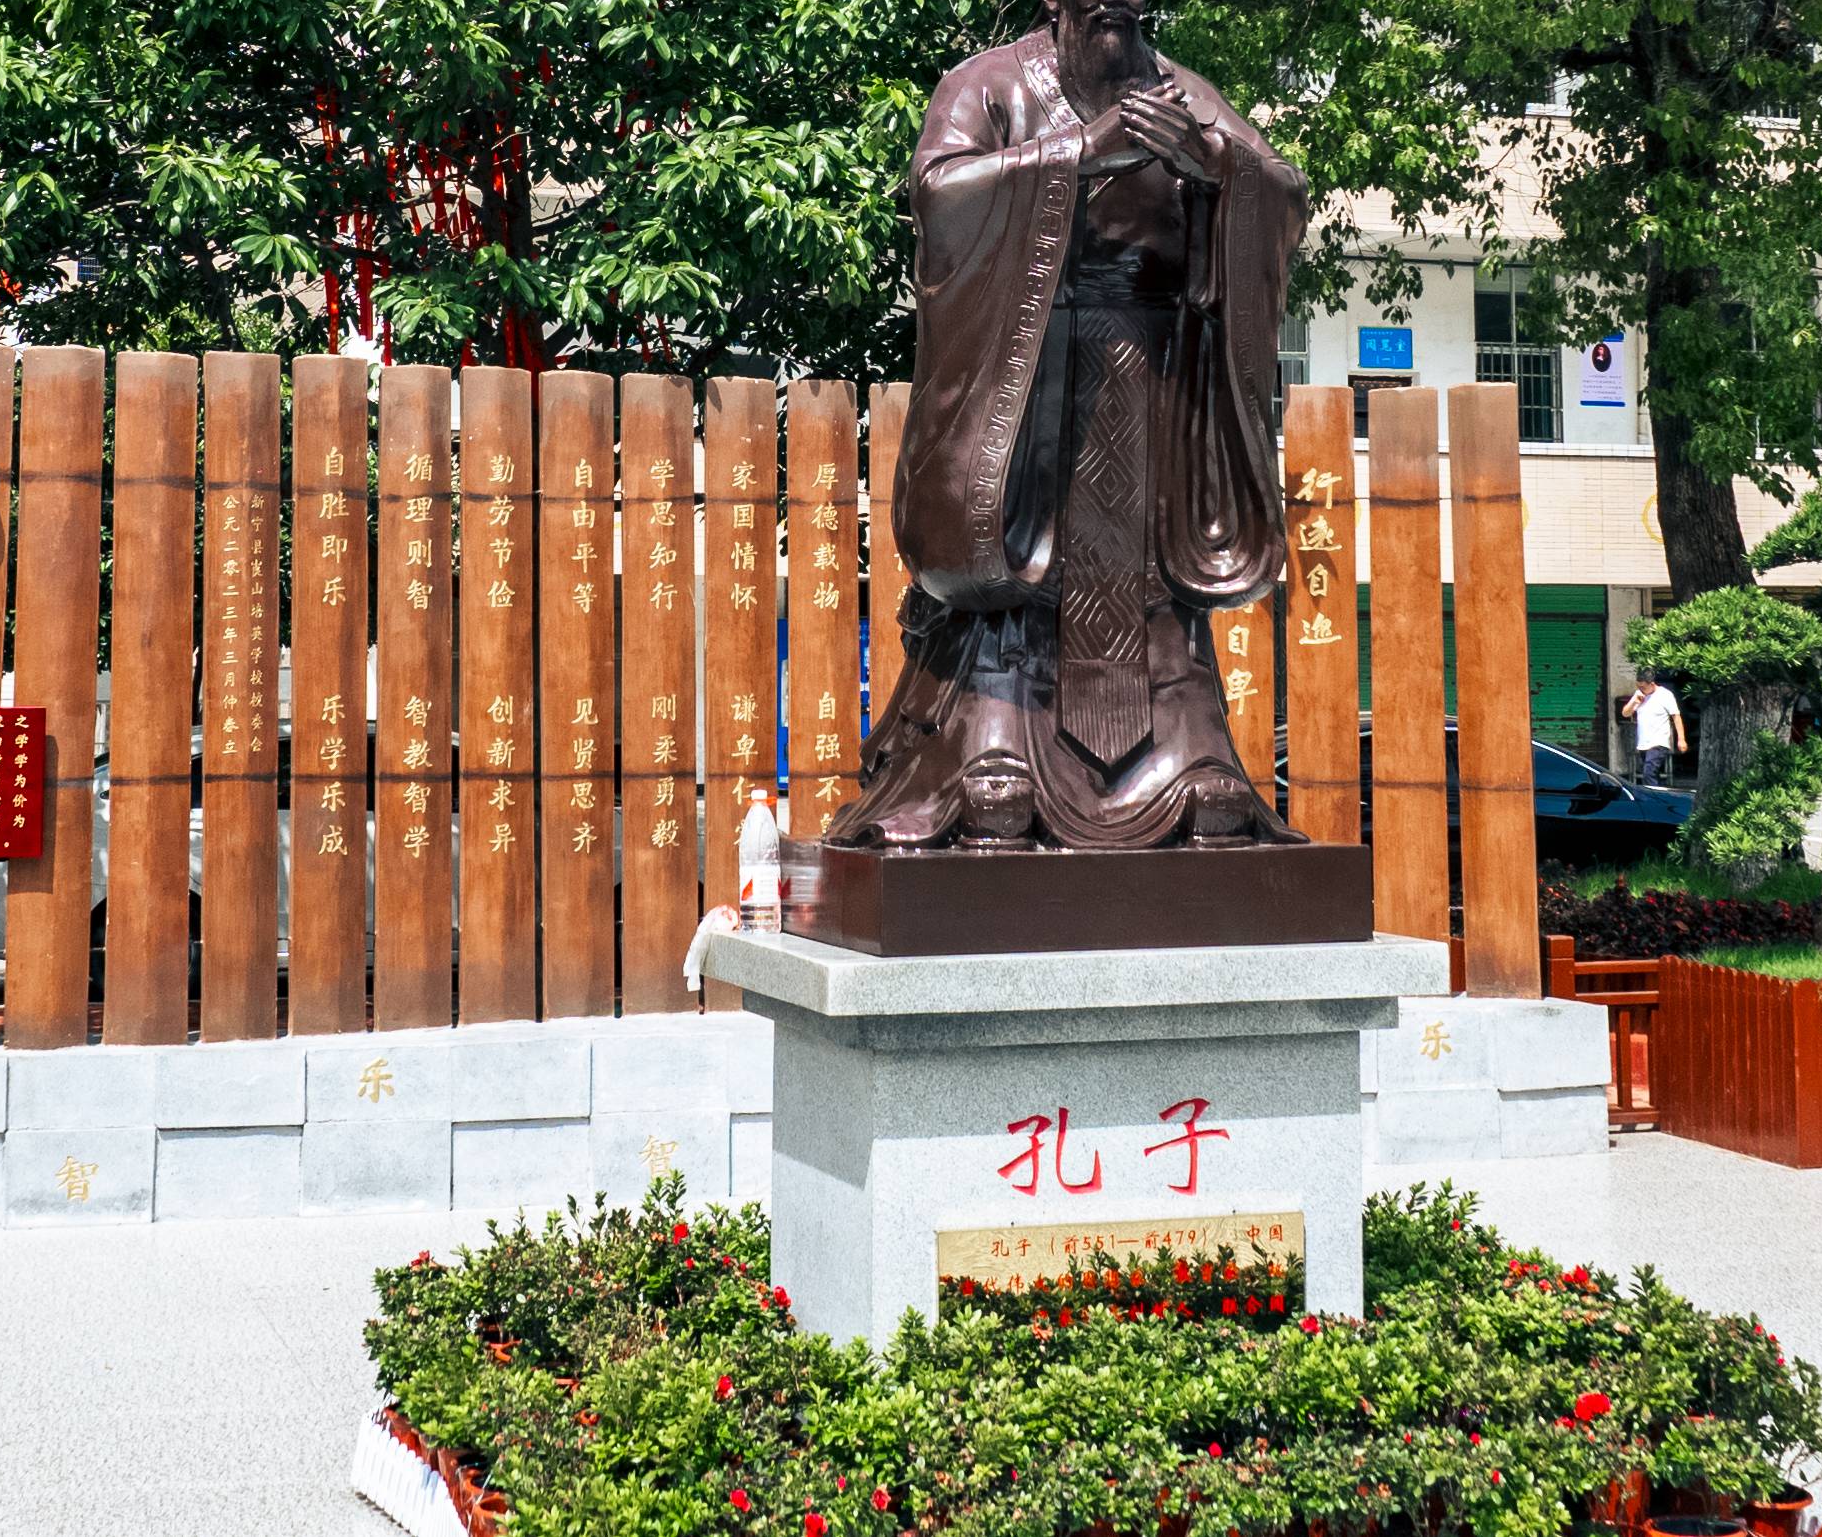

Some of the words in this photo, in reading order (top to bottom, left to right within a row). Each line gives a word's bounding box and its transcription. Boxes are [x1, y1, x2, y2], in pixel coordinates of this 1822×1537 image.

[318, 445, 351, 606] 自胜即乐
[401, 451, 433, 610] 循理则智
[486, 453, 517, 609] 勤劳节俭
[570, 458, 599, 615] 自由平等
[648, 457, 678, 611] 学思知行
[730, 461, 759, 611] 家国情怀
[810, 461, 841, 611] 厚德载物
[1223, 602, 1260, 717] 自卑
[317, 693, 349, 857] 乐学乐成
[402, 694, 434, 858] 智教智学
[486, 694, 517, 854] 创新求异
[569, 697, 599, 854] 见贤思齐
[650, 694, 680, 849] 刚柔勇毅
[730, 693, 760, 846] 谦卑仁
[356, 1057, 396, 1104] 乐
[1419, 1020, 1453, 1061] 乐
[55, 1155, 99, 1202] 智
[638, 1133, 678, 1177] 智
[997, 1097, 1231, 1197] 孔子
